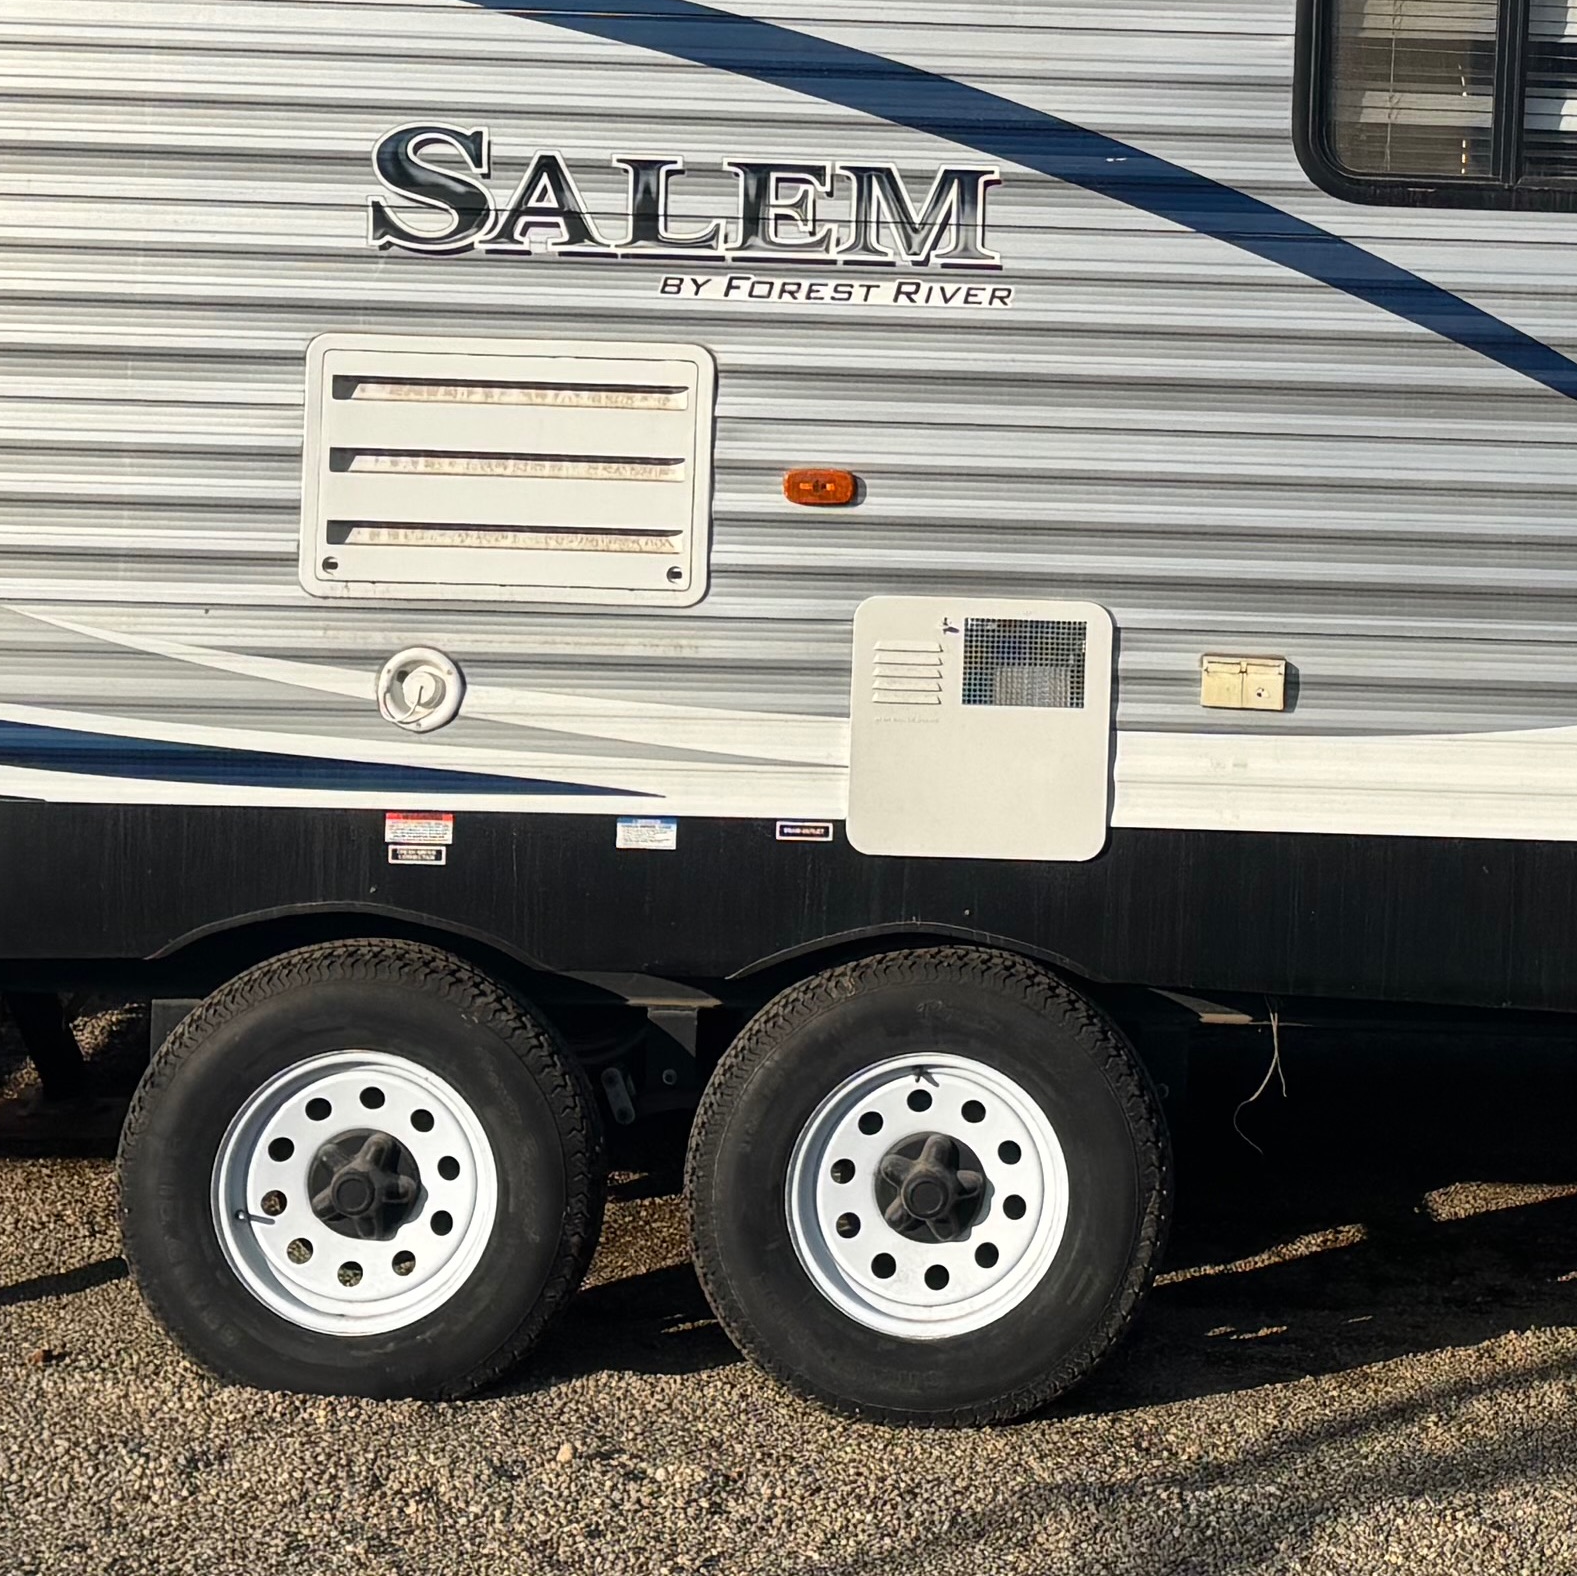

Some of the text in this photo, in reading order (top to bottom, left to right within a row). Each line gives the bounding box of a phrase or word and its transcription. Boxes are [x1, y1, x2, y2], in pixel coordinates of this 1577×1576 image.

[369, 121, 1003, 271] SALEM
[660, 274, 1014, 307] BY FOREST RIVER
